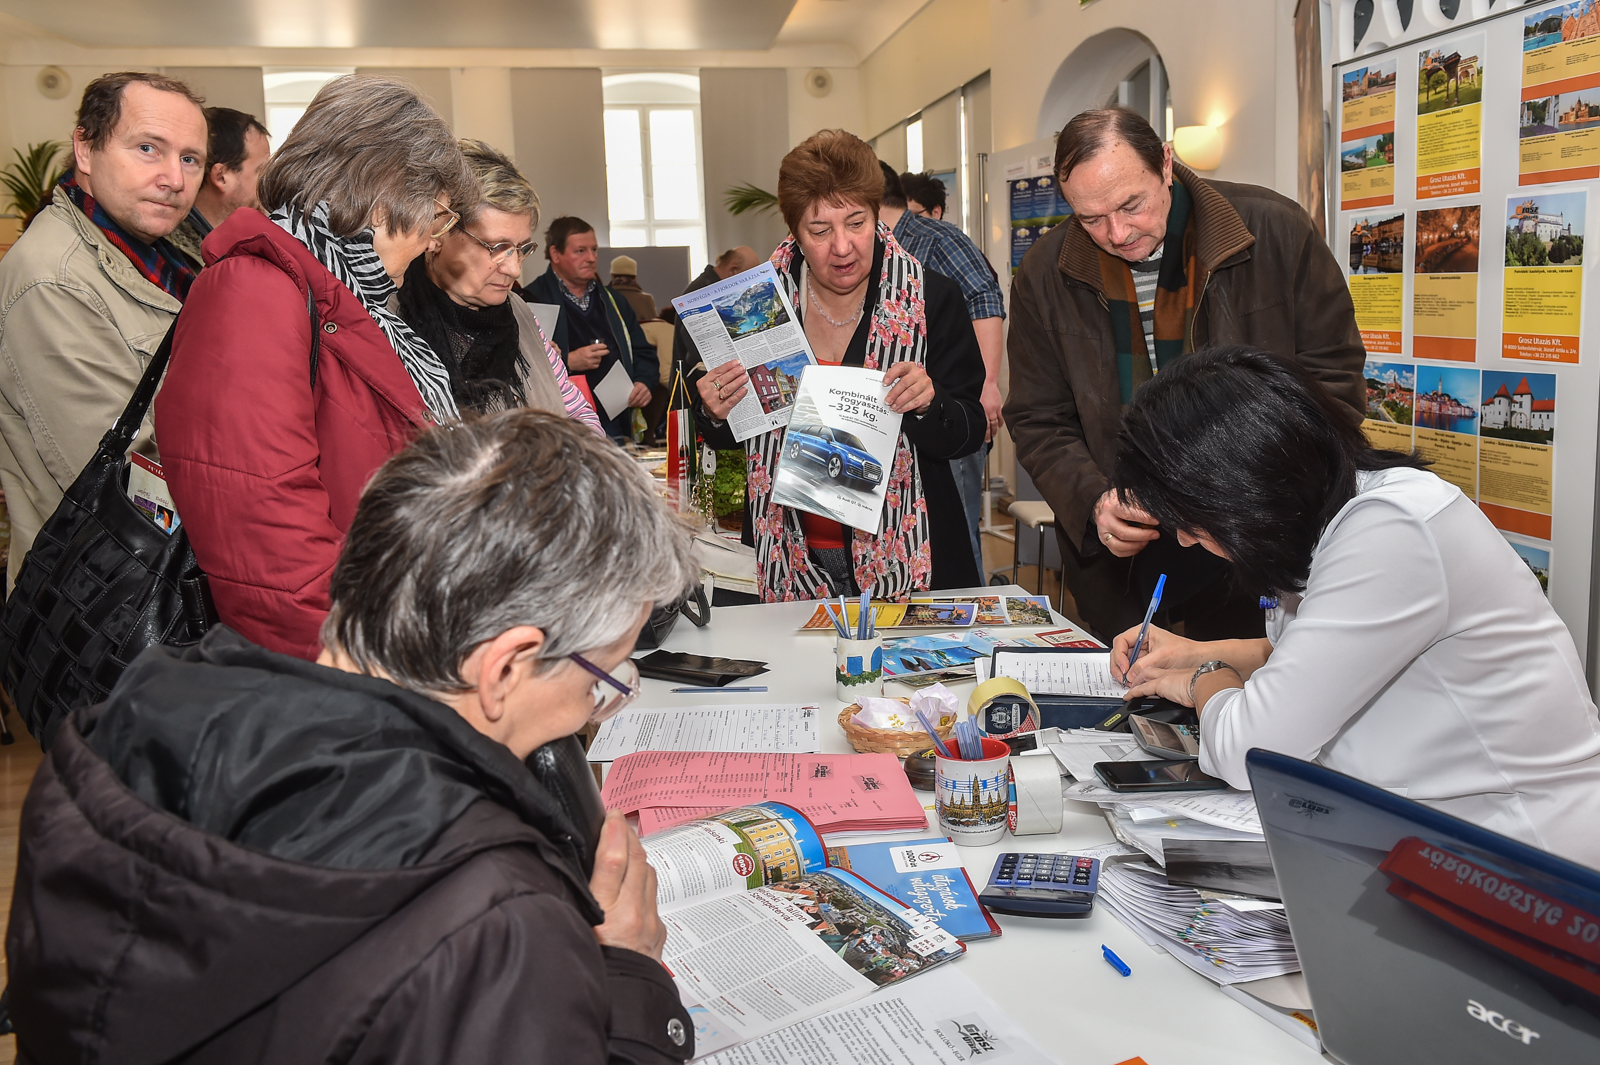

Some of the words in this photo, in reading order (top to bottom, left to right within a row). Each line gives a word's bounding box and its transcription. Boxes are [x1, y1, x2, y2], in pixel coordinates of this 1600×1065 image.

[1533, 337, 1551, 345] Utazás
[829, 388, 878, 403] Kombinált
[840, 395, 890, 416] fogyasztás:
[863, 409, 878, 422] kg.
[1008, 811, 1017, 829] tesa
[736, 855, 749, 876] 100%
[931, 874, 967, 910] utazások
[749, 892, 794, 922] Szentpétervár
[784, 903, 808, 922] Tallinn
[1466, 999, 1541, 1046] acer
[962, 1023, 995, 1052] Grosz
